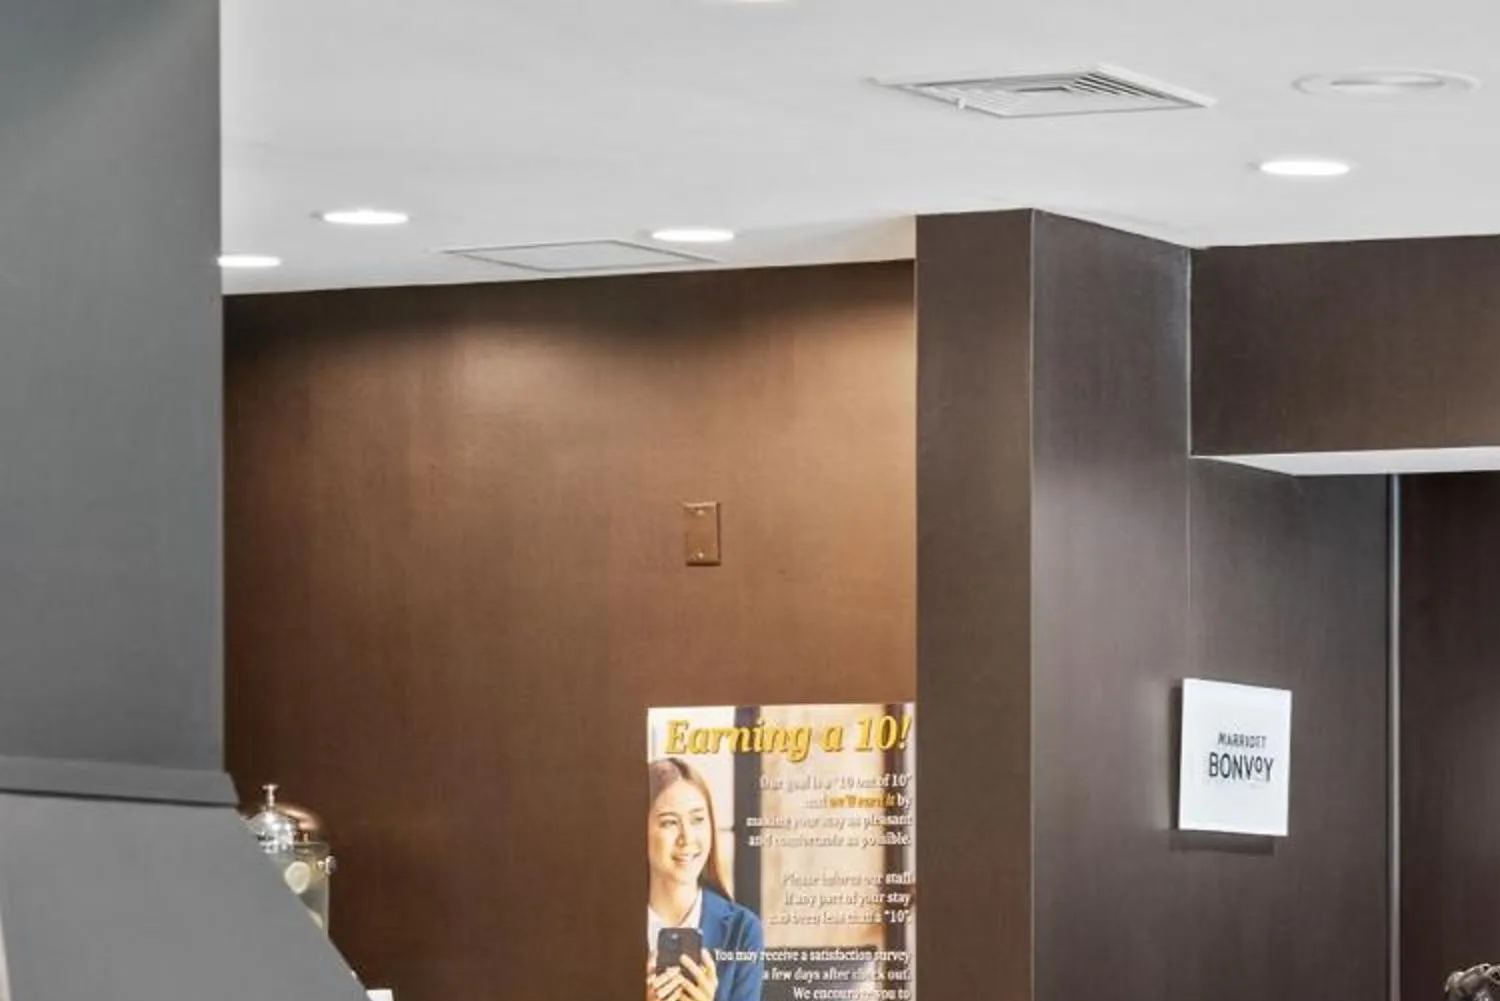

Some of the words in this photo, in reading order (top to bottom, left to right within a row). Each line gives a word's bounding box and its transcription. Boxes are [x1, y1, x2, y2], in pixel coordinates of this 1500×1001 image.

[666, 717, 813, 763] Earning
[822, 724, 846, 752] a
[856, 715, 912, 752] 10!
[1217, 731, 1267, 749] MARRIOTT
[1208, 751, 1275, 782] BONVOY
[897, 793, 911, 810] by
[885, 871, 912, 885] staff
[886, 892, 911, 909] stay
[714, 948, 733, 961] You
[735, 949, 758, 964] may
[760, 948, 800, 962] receive
[801, 951, 808, 962] a
[809, 948, 872, 962] satisfaction
[873, 950, 910, 965] survey
[762, 971, 768, 980] a
[770, 967, 793, 980] few
[794, 967, 820, 983] days
[822, 967, 850, 981] after
[793, 987, 811, 1000] We
[898, 988, 911, 1000] to
